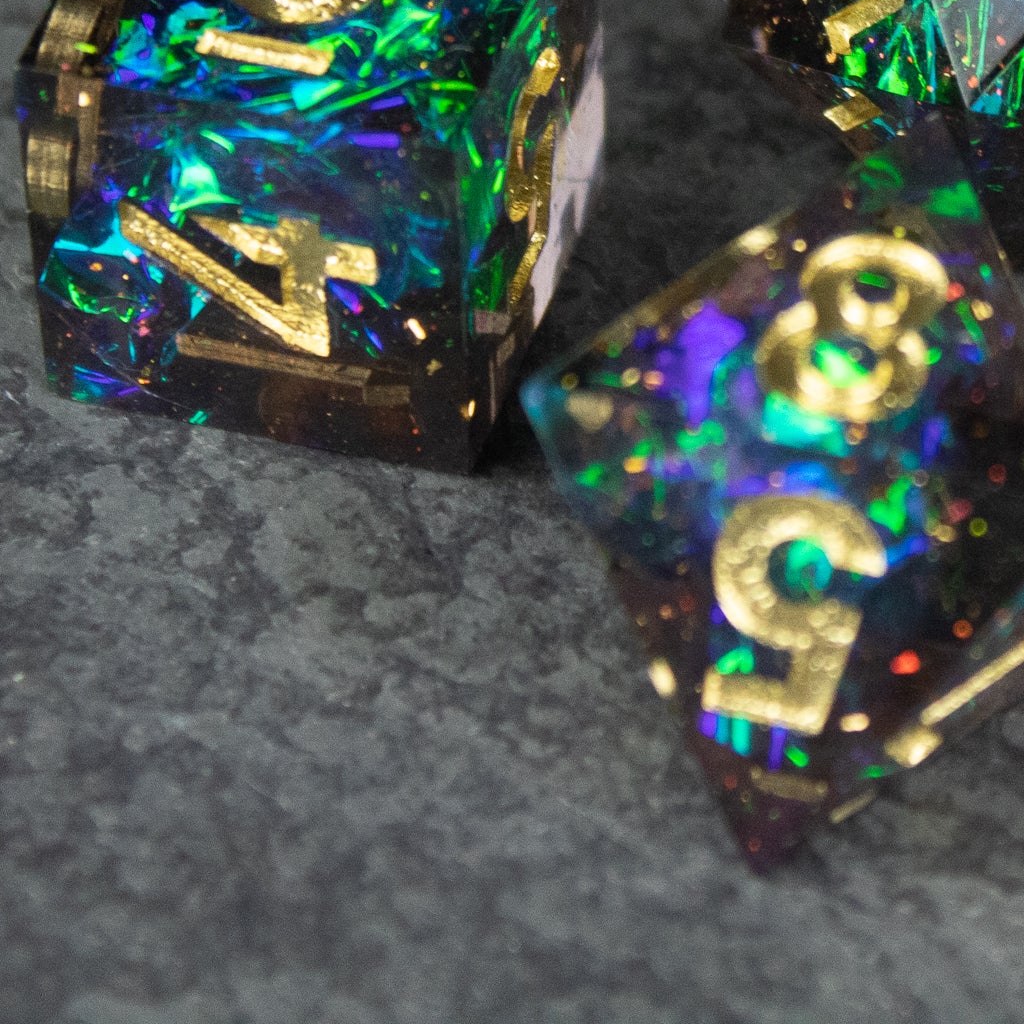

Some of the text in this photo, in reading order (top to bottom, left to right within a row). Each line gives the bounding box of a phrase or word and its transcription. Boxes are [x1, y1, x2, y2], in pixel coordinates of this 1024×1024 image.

[117, 197, 379, 357] 4
[756, 234, 948, 422] 8
[701, 493, 888, 737] 5
